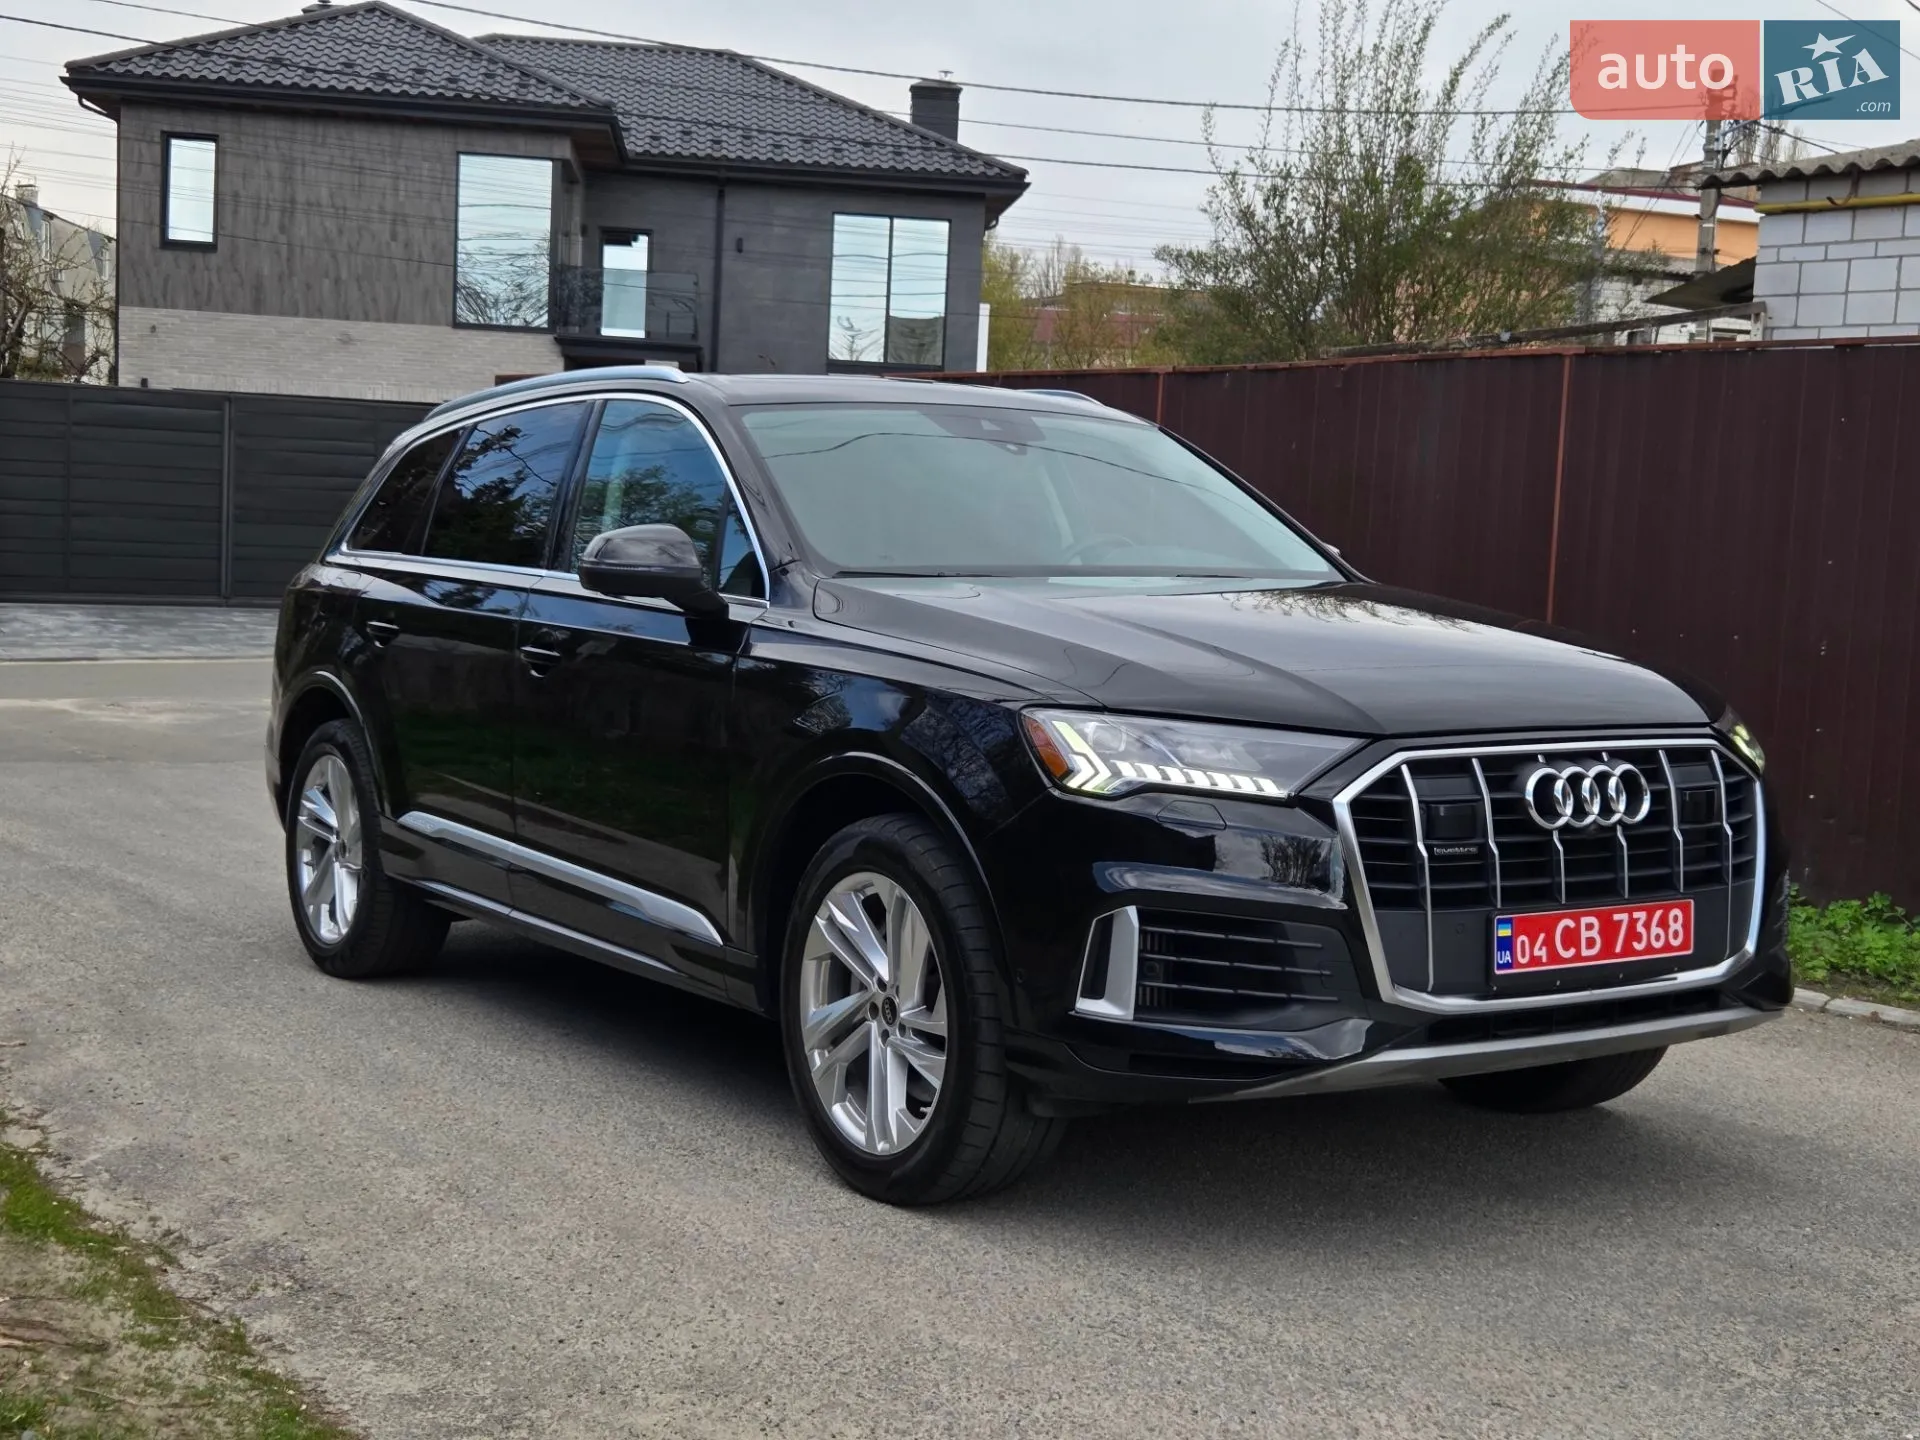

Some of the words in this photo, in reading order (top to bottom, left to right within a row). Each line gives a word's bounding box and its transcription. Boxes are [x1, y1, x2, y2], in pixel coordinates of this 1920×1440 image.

[1516, 933, 1547, 964] 04
[1554, 916, 1600, 958] CB
[1612, 908, 1683, 953] 7368
[1497, 951, 1512, 964] UA
